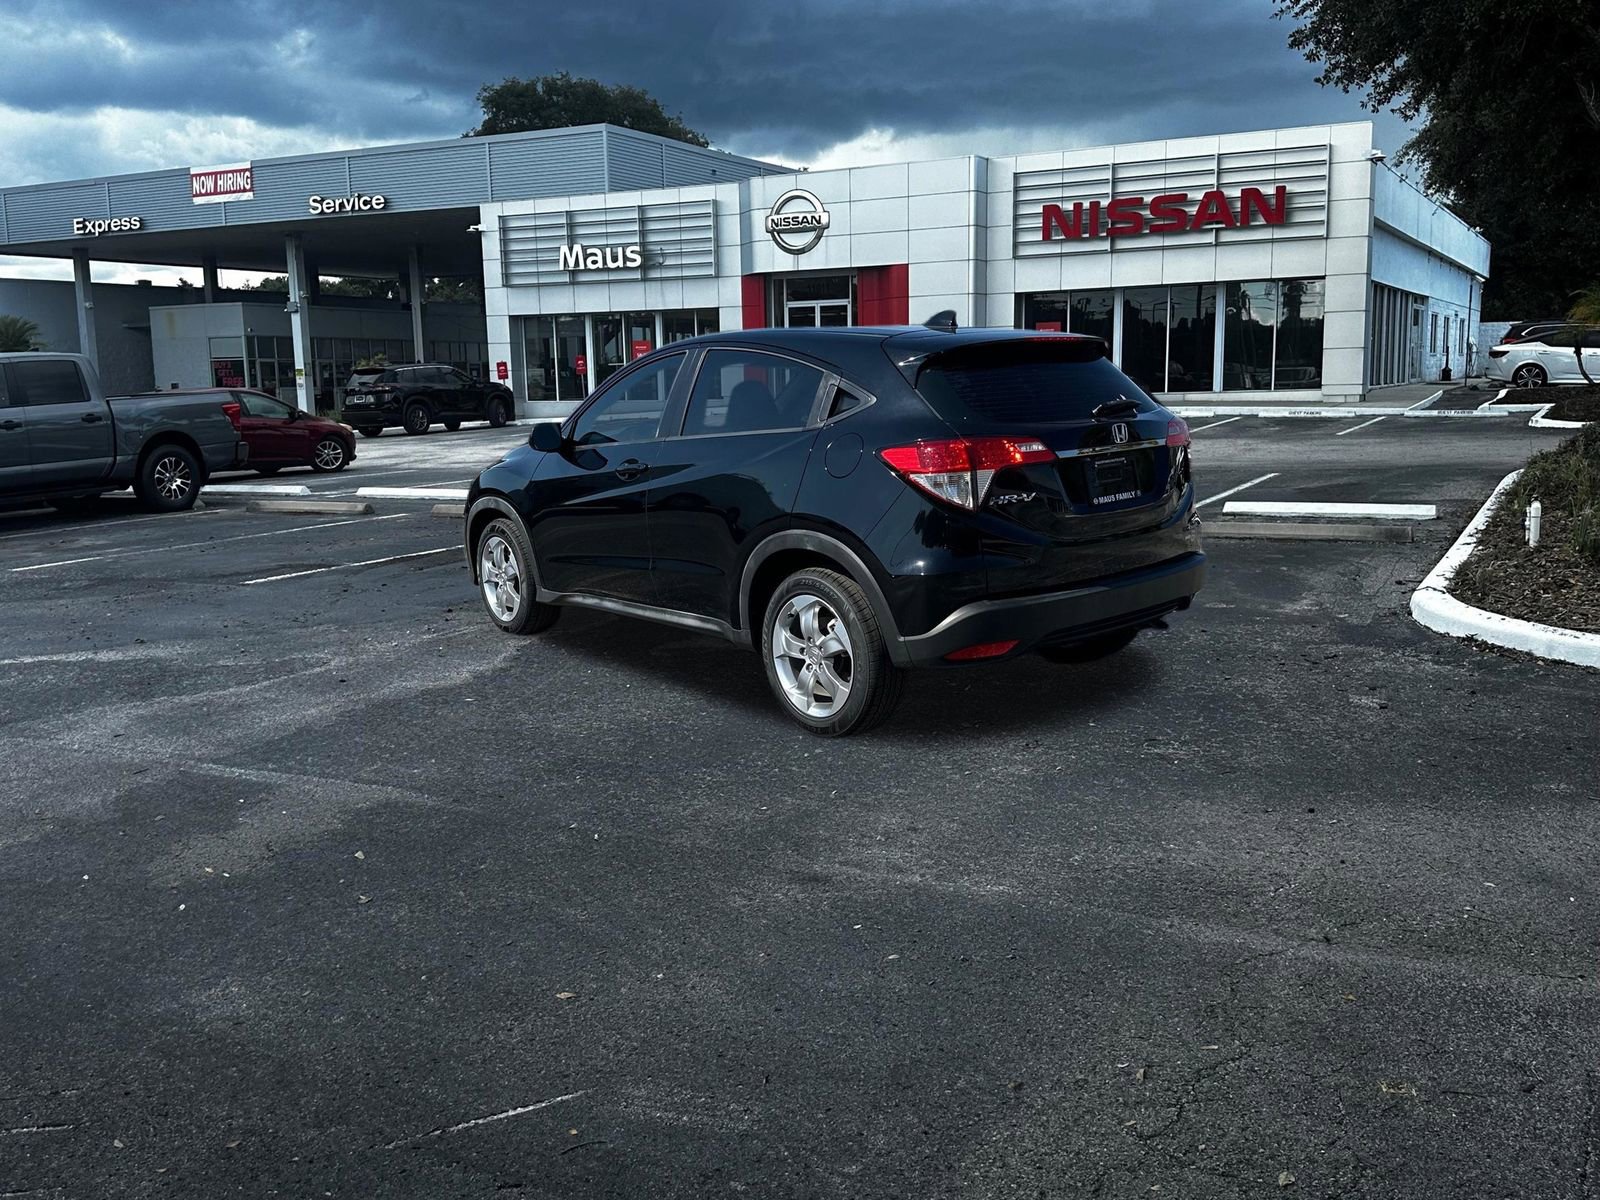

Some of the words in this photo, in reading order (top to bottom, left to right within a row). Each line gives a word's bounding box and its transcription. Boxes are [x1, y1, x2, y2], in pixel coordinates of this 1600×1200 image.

[192, 174, 215, 195] NOW
[216, 171, 251, 193] HIRING
[309, 193, 385, 215] Service
[1042, 185, 1287, 241] NISSAN
[73, 216, 141, 236] Express
[770, 214, 822, 228] NISSAN
[559, 243, 642, 270] Maus
[989, 492, 1037, 506] HR-V
[1098, 494, 1116, 504] MAUS
[1115, 490, 1136, 501] FAMILY
